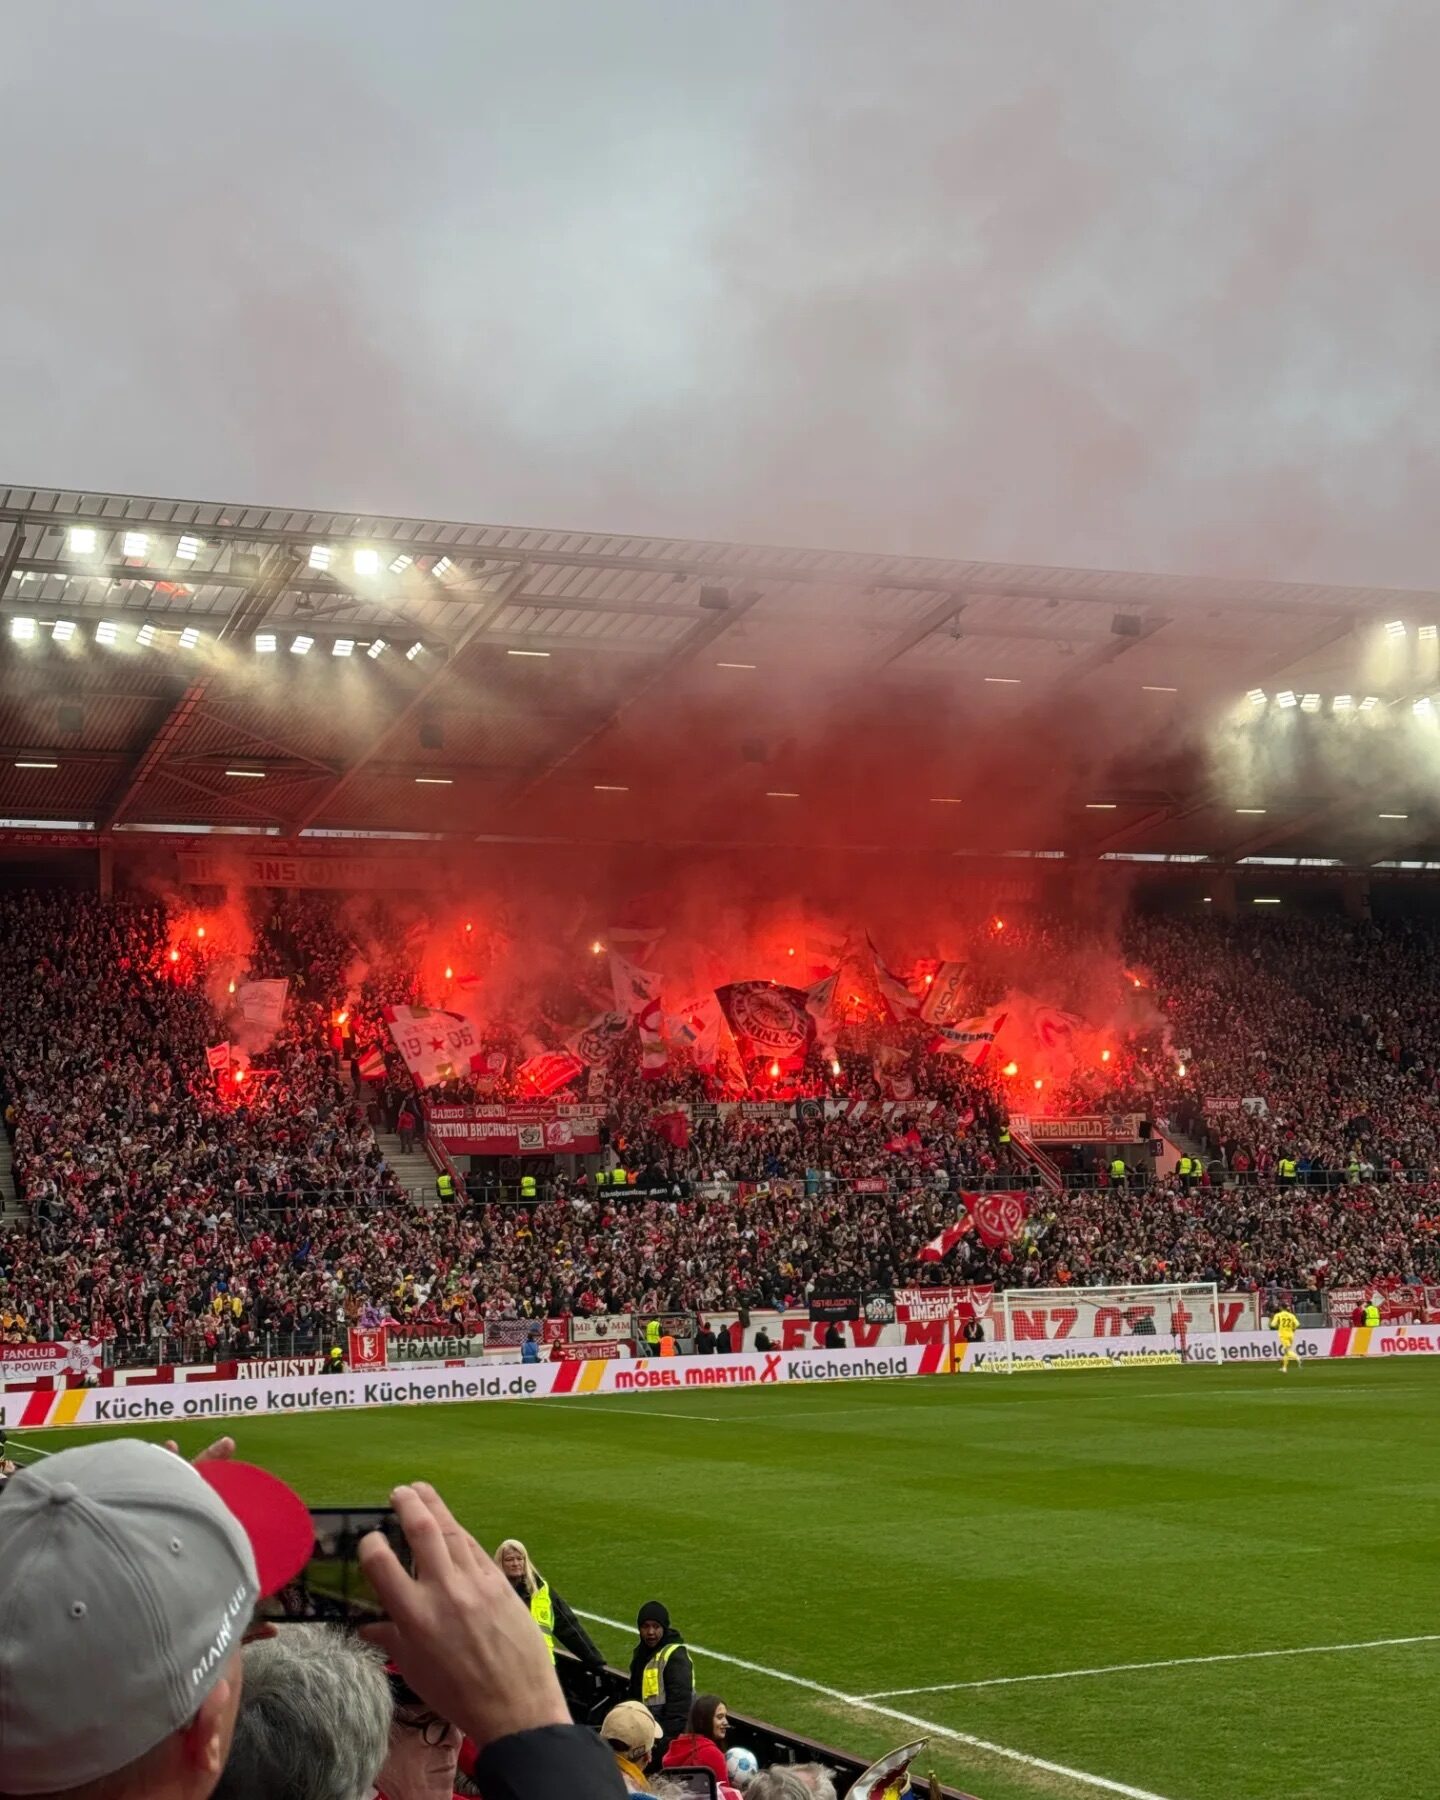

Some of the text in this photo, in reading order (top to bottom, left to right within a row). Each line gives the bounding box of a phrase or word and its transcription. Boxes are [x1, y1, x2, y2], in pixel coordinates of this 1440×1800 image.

[470, 1123, 517, 1137] BRUCHWEG
[904, 1308, 1079, 1345] MINZ
[397, 1340, 472, 1359] FRAUEN
[1185, 1339, 1318, 1361] Kücenhelde
[1380, 1328, 1434, 1352] MÖBEL
[3, 1347, 57, 1360] FANCLUB
[615, 1360, 681, 1389] MÖBEL
[685, 1365, 756, 1384] MARTIN
[788, 1357, 908, 1380] Küchenheld
[982, 1361, 1044, 1371] WÄRMPUMPEN
[95, 1376, 537, 1420] Küche online kaufen: Küchenheld.de
